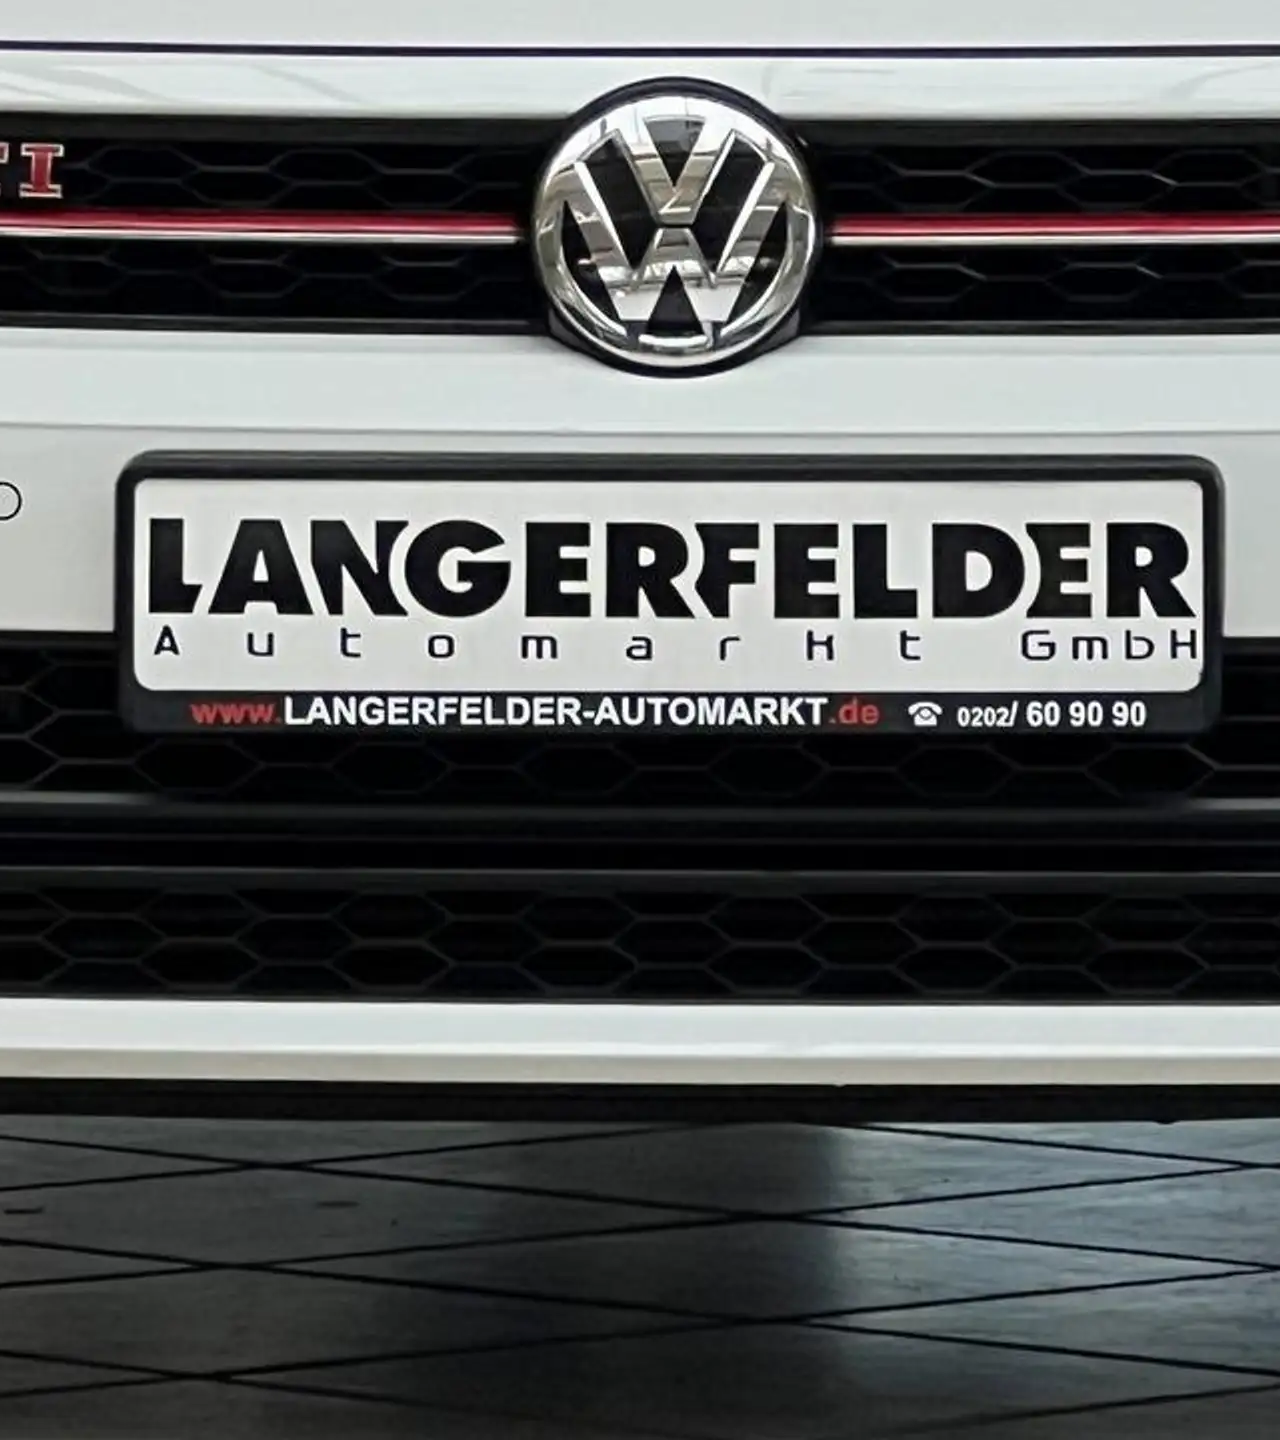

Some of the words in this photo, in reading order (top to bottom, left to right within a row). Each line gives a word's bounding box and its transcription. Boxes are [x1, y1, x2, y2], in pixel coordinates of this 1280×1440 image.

[148, 517, 1196, 619] LANGERFELDER
[154, 625, 921, 661] Automarkt
[1021, 629, 1197, 661] GmbH
[191, 696, 880, 726] www.LANGERFELDER-AUTOMARKT.de
[1026, 700, 1061, 728] 60
[1068, 700, 1104, 728] 90
[1111, 700, 1147, 728] 90
